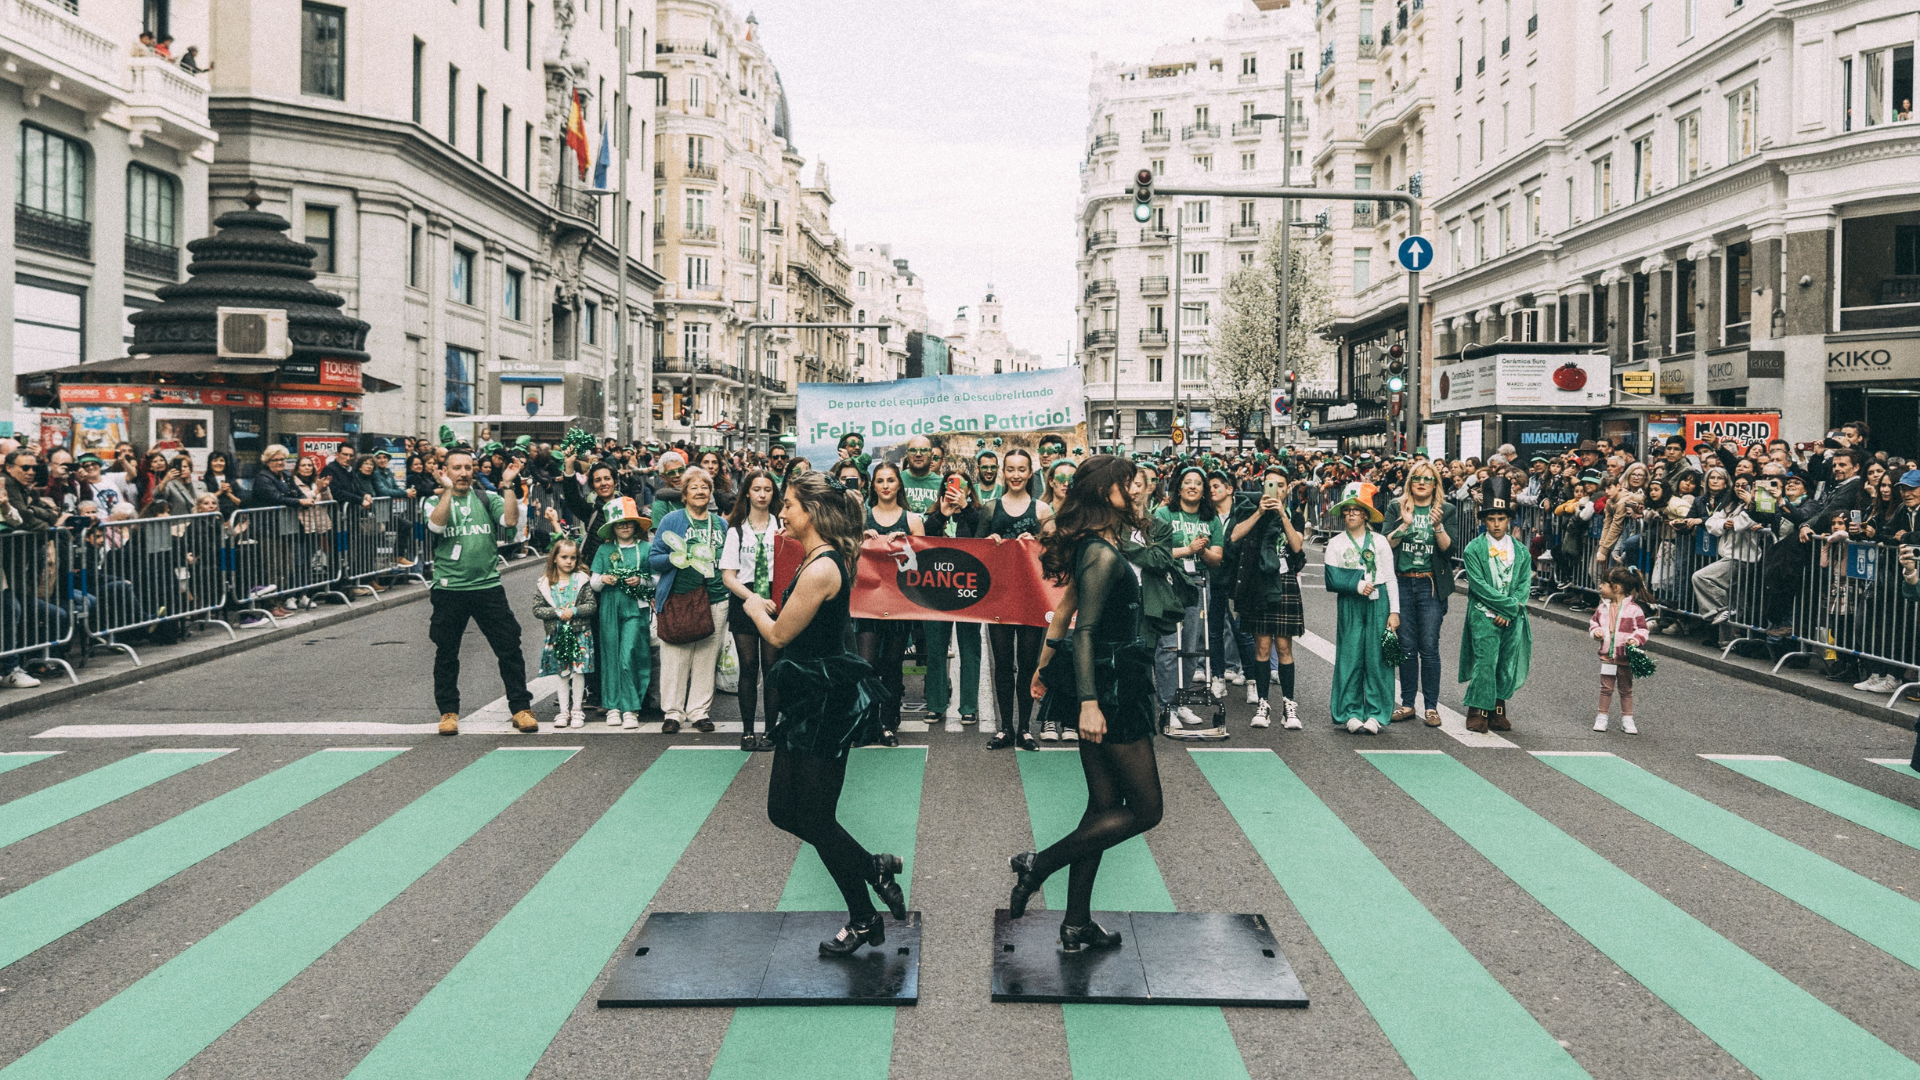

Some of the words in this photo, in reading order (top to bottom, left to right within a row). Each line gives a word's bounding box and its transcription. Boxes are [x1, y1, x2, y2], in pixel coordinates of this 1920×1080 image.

[1750, 359, 1779, 367] KIKO
[1828, 349, 1892, 368] KIKO
[324, 361, 353, 375] TOURS
[1708, 361, 1734, 378] KIKO
[161, 389, 190, 397] MADRID
[828, 399, 844, 409] De
[846, 399, 877, 411] parte
[879, 397, 897, 407] del
[899, 395, 935, 408] equipo
[936, 393, 950, 403] de
[953, 387, 1054, 404] @DescubreIrlanda
[810, 421, 866, 444] ¡Feliz
[871, 418, 906, 437] Día
[910, 417, 935, 435] de
[938, 414, 979, 432] San
[983, 406, 1072, 430] Patricio!
[1695, 422, 1769, 440] MADRID
[1521, 432, 1579, 444] IMAGINARY
[934, 562, 954, 572] UCD
[906, 570, 978, 590] DANCE
[957, 588, 978, 598] SOC
